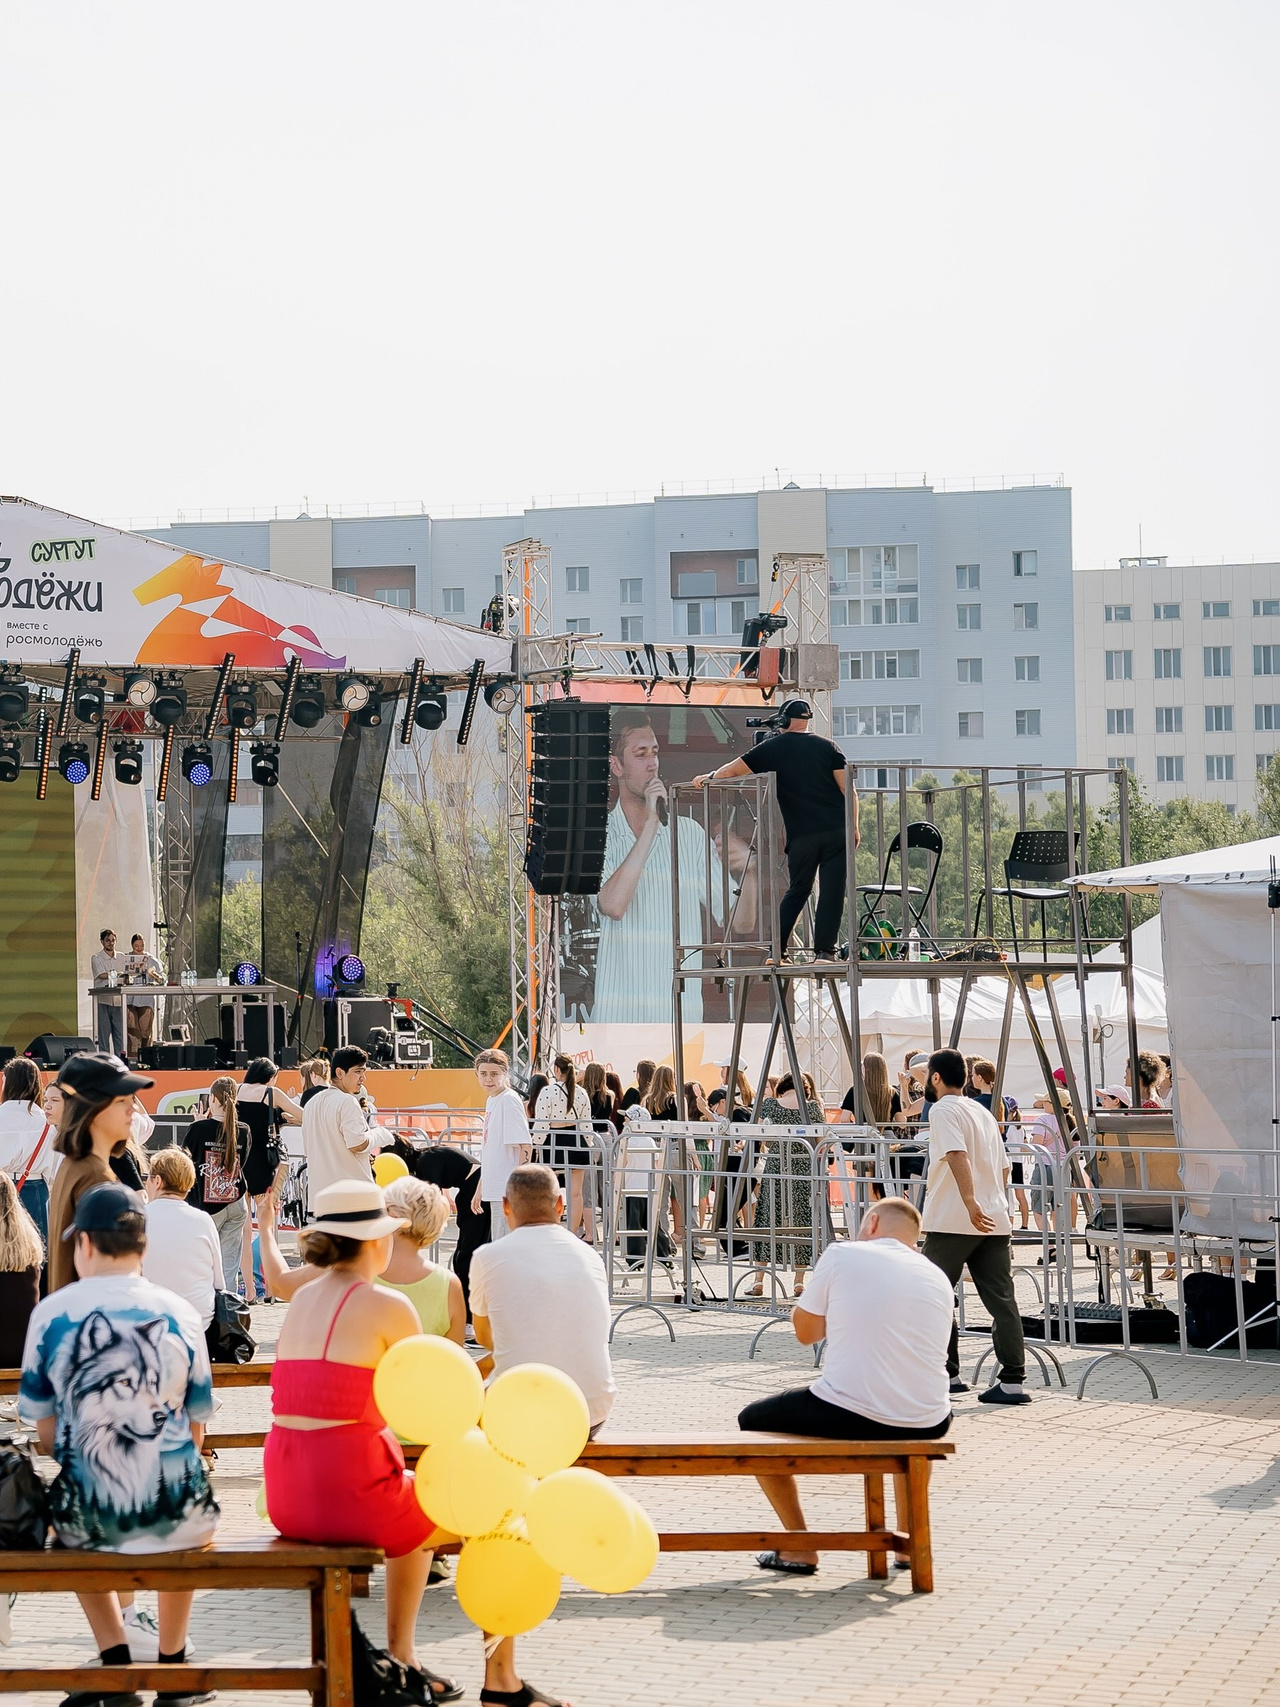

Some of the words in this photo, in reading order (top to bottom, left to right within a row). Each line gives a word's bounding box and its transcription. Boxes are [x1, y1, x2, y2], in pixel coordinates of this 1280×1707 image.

[31, 538, 96, 563] СУРГУТ
[6, 621, 40, 630] вместе
[42, 622, 48, 631] с
[6, 634, 103, 648] росмолодёжь
